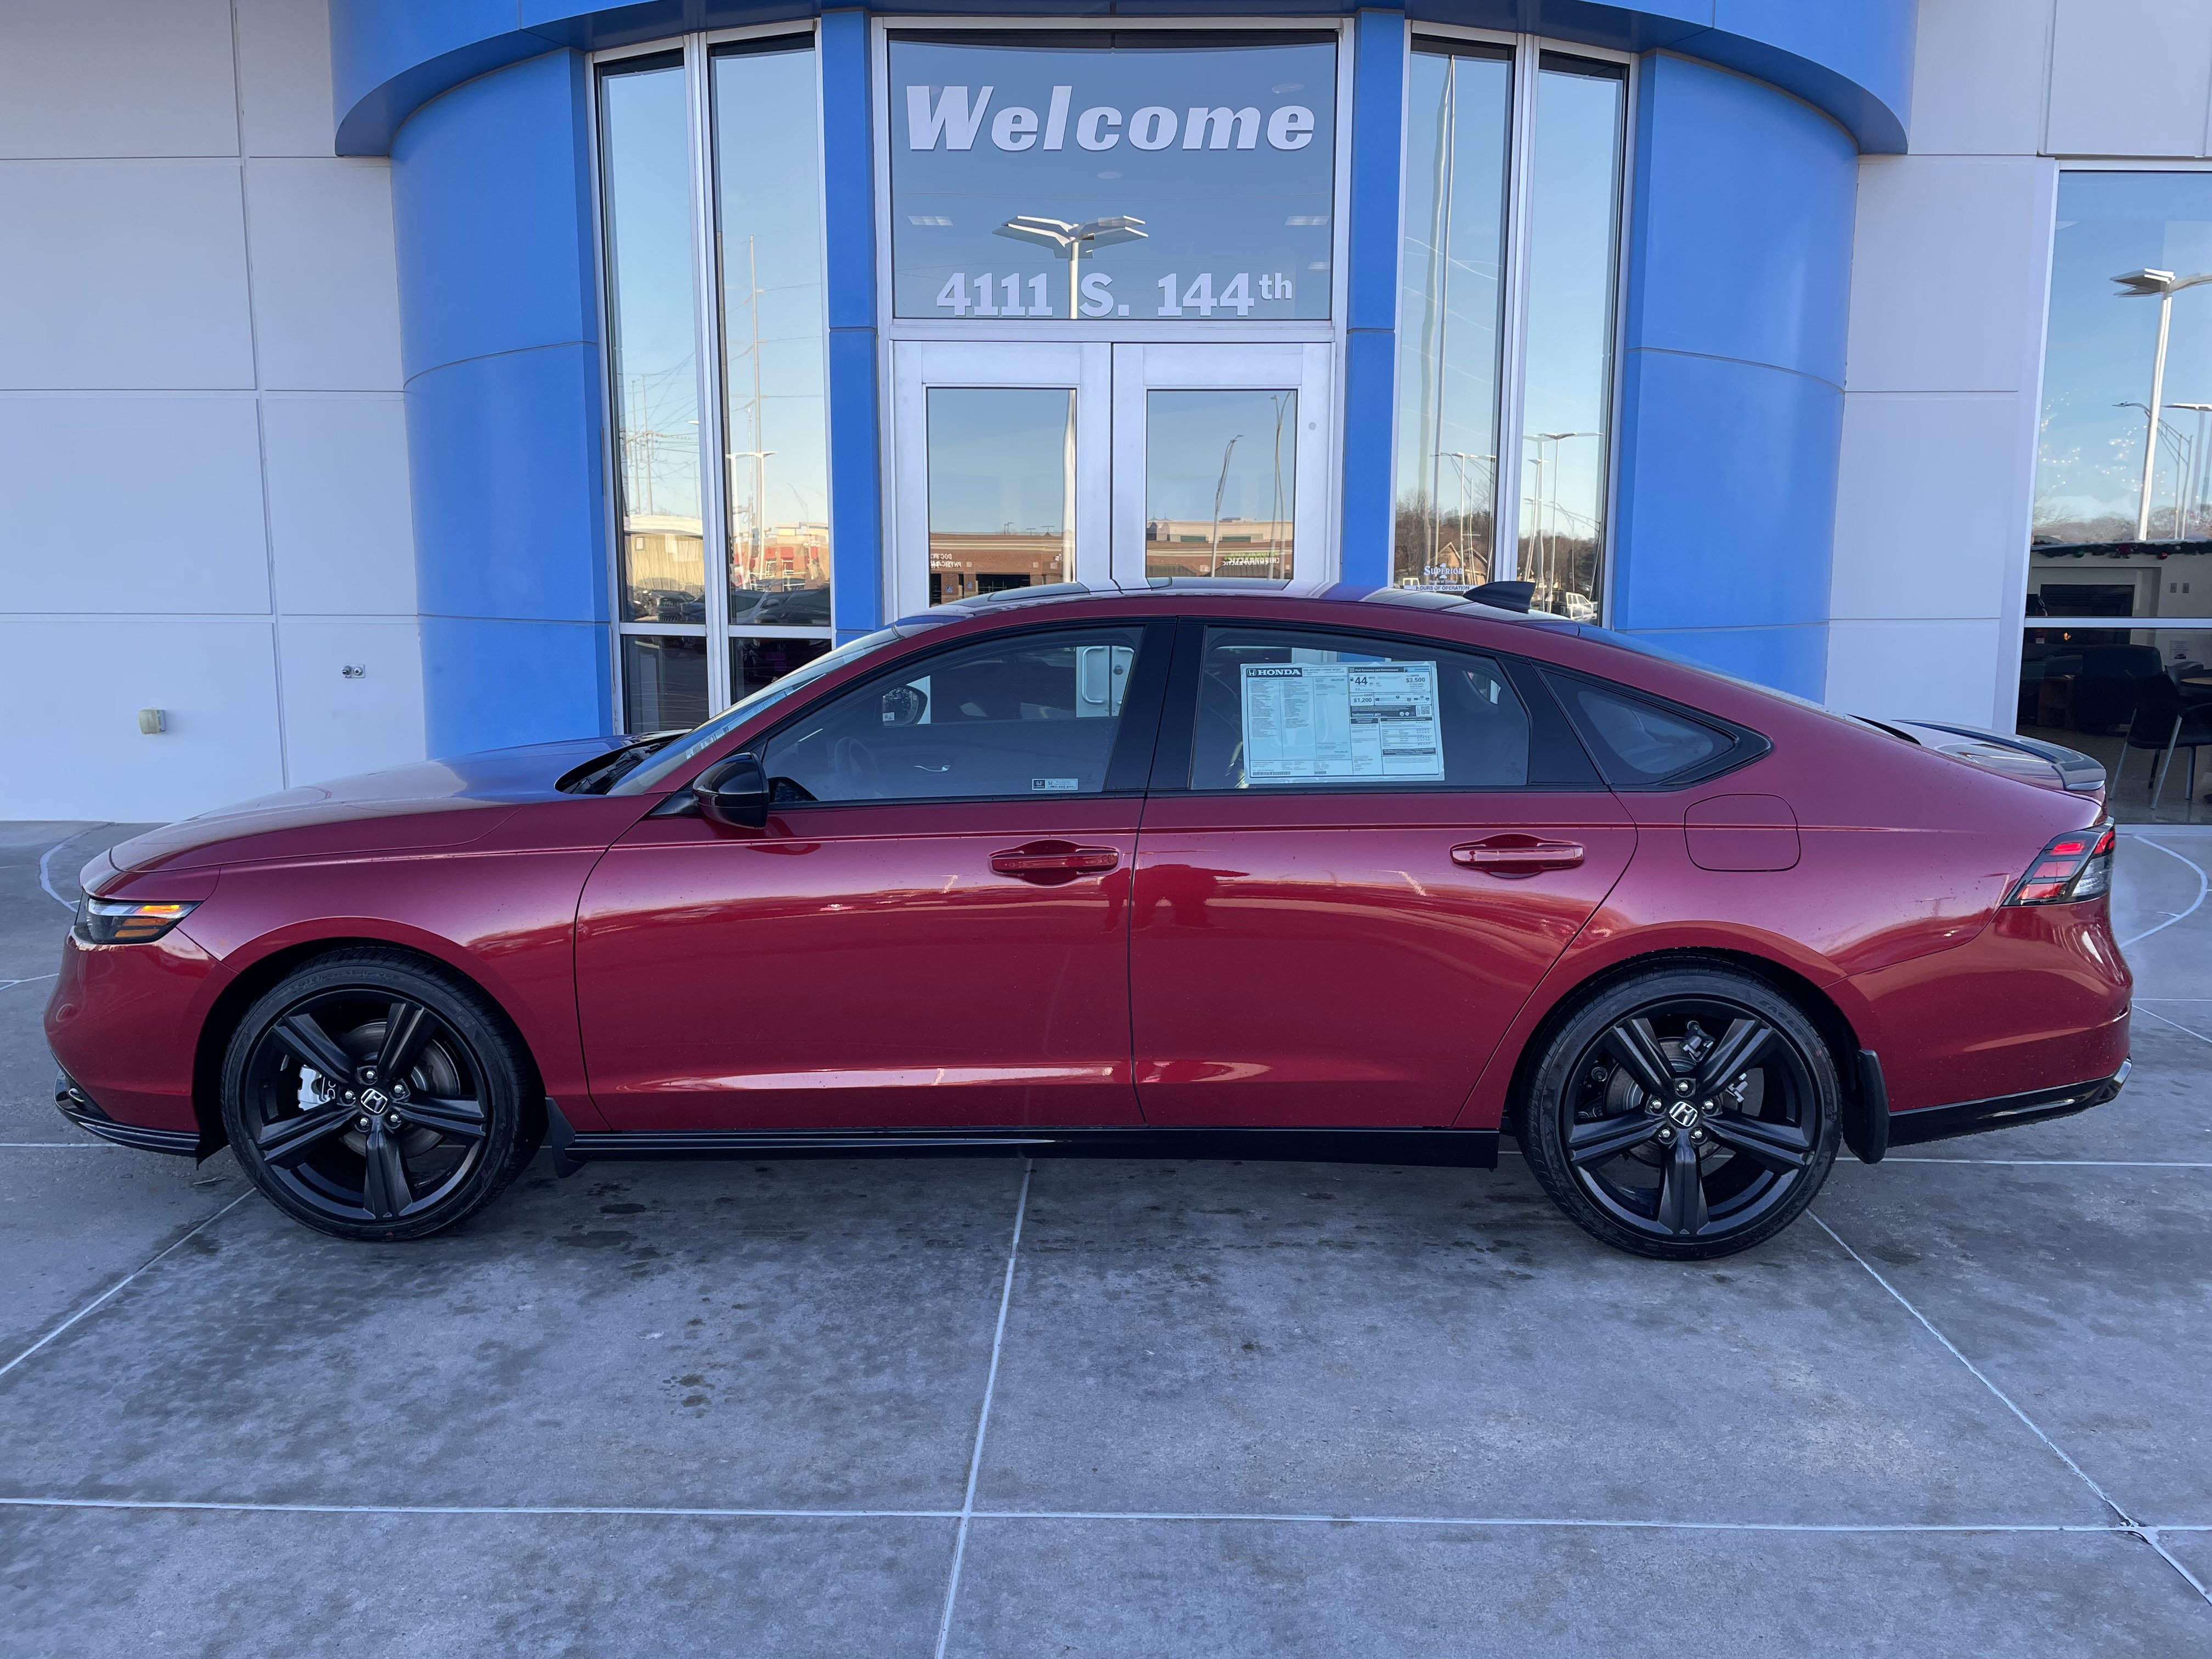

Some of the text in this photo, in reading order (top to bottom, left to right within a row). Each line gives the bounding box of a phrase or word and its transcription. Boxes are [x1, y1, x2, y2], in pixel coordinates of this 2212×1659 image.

[906, 86, 1315, 151] Welcome
[936, 273, 1053, 316] 4111
[1079, 273, 1130, 317] S.
[1355, 676, 1368, 685] 44
